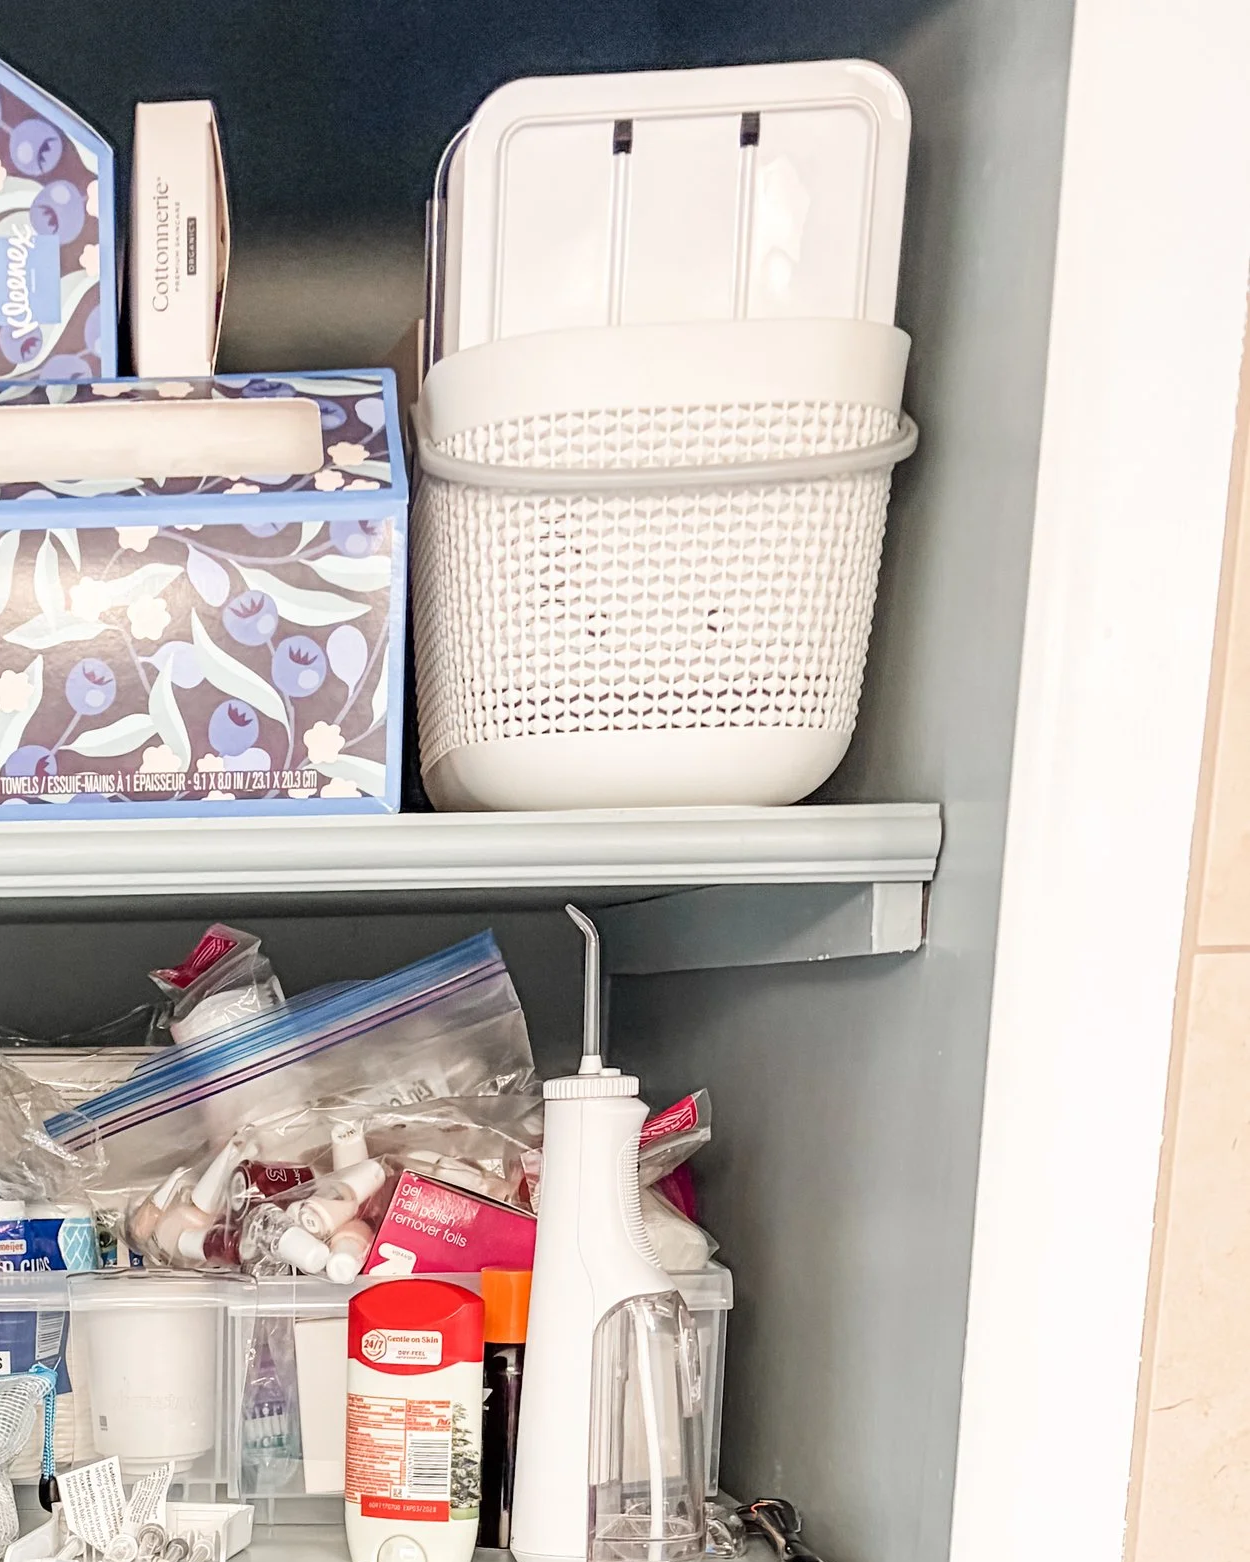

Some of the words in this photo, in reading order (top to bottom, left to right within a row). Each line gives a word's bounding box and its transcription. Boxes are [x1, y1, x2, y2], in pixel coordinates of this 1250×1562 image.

[152, 182, 169, 312] Cottonnerie
[187, 218, 196, 273] ORGANICS
[1, 223, 38, 339] Kleenex
[0, 776, 40, 795] TOWELS
[47, 774, 116, 794] ESSUIE-MAINS
[134, 770, 186, 792] ÉPAISSEUR
[193, 773, 207, 791] 9.1
[217, 772, 232, 791] 8.0
[233, 772, 244, 790] IN
[252, 771, 272, 790] 23.1
[281, 770, 301, 789] 20.3
[400, 1181, 422, 1198] gel
[395, 1196, 418, 1212] nail
[418, 1203, 456, 1228] polish
[390, 1211, 442, 1237] remover
[442, 1228, 468, 1248] foils
[363, 1339, 384, 1352] 24/7
[387, 1335, 411, 1345] Gentle
[421, 1336, 440, 1344] Skin
